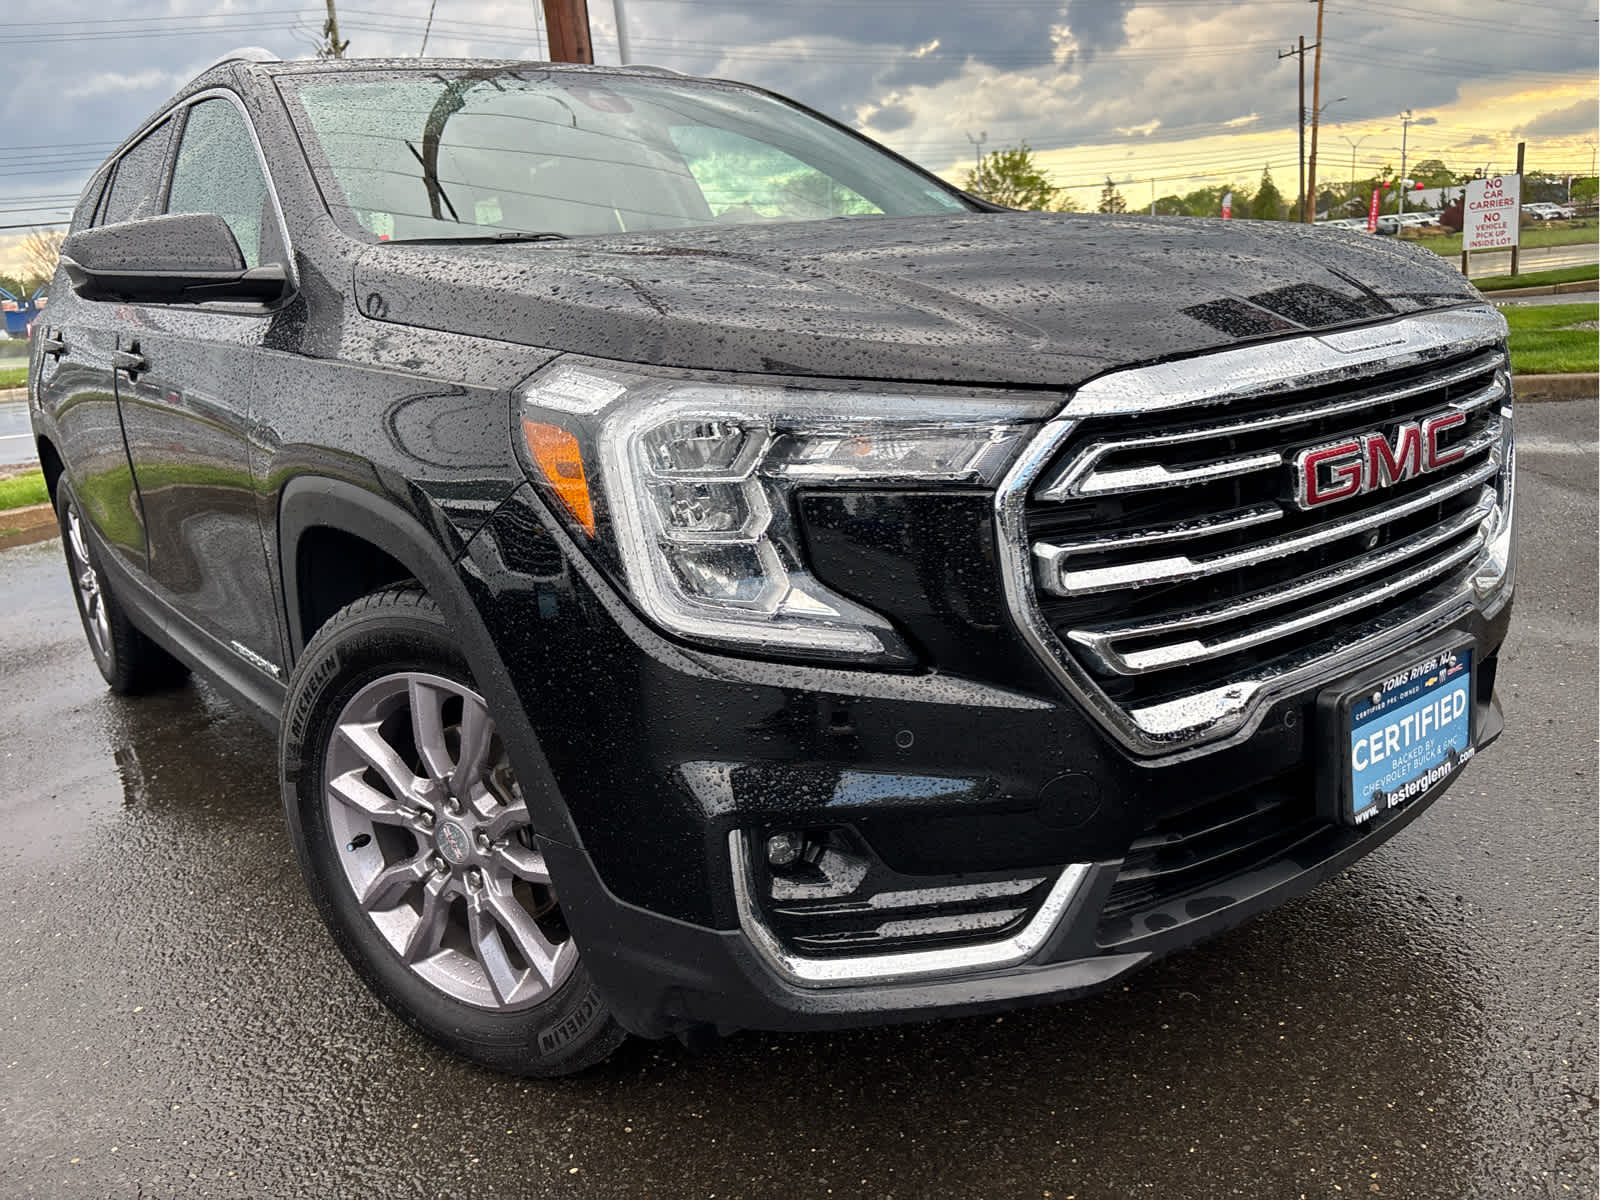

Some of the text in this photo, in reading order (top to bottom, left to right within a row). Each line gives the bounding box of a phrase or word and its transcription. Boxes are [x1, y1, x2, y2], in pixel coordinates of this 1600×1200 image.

[1483, 190, 1503, 199] CAR
[1485, 179, 1503, 189] NO
[1469, 197, 1514, 210] CARRIERS
[1475, 221, 1507, 231] VEHICLE
[1483, 212, 1501, 222] NO
[1470, 237, 1511, 247] INSIDE LOT
[1476, 231, 1494, 239] PICK
[1298, 411, 1466, 511] GMC
[1382, 672, 1409, 693] TOMS
[1440, 650, 1452, 666] NJ
[291, 653, 337, 739] MICHELIN
[1355, 702, 1386, 721] CERTIFIED
[1351, 688, 1466, 772] CERTIFIED
[1362, 764, 1411, 796] CHEVROLET
[1414, 750, 1435, 769] BUICK
[1443, 735, 1457, 750] GMC
[1392, 739, 1435, 769] BACKED BY
[1354, 747, 1475, 825] www. lesterglenn .com
[541, 991, 602, 1052] ICHELIN
